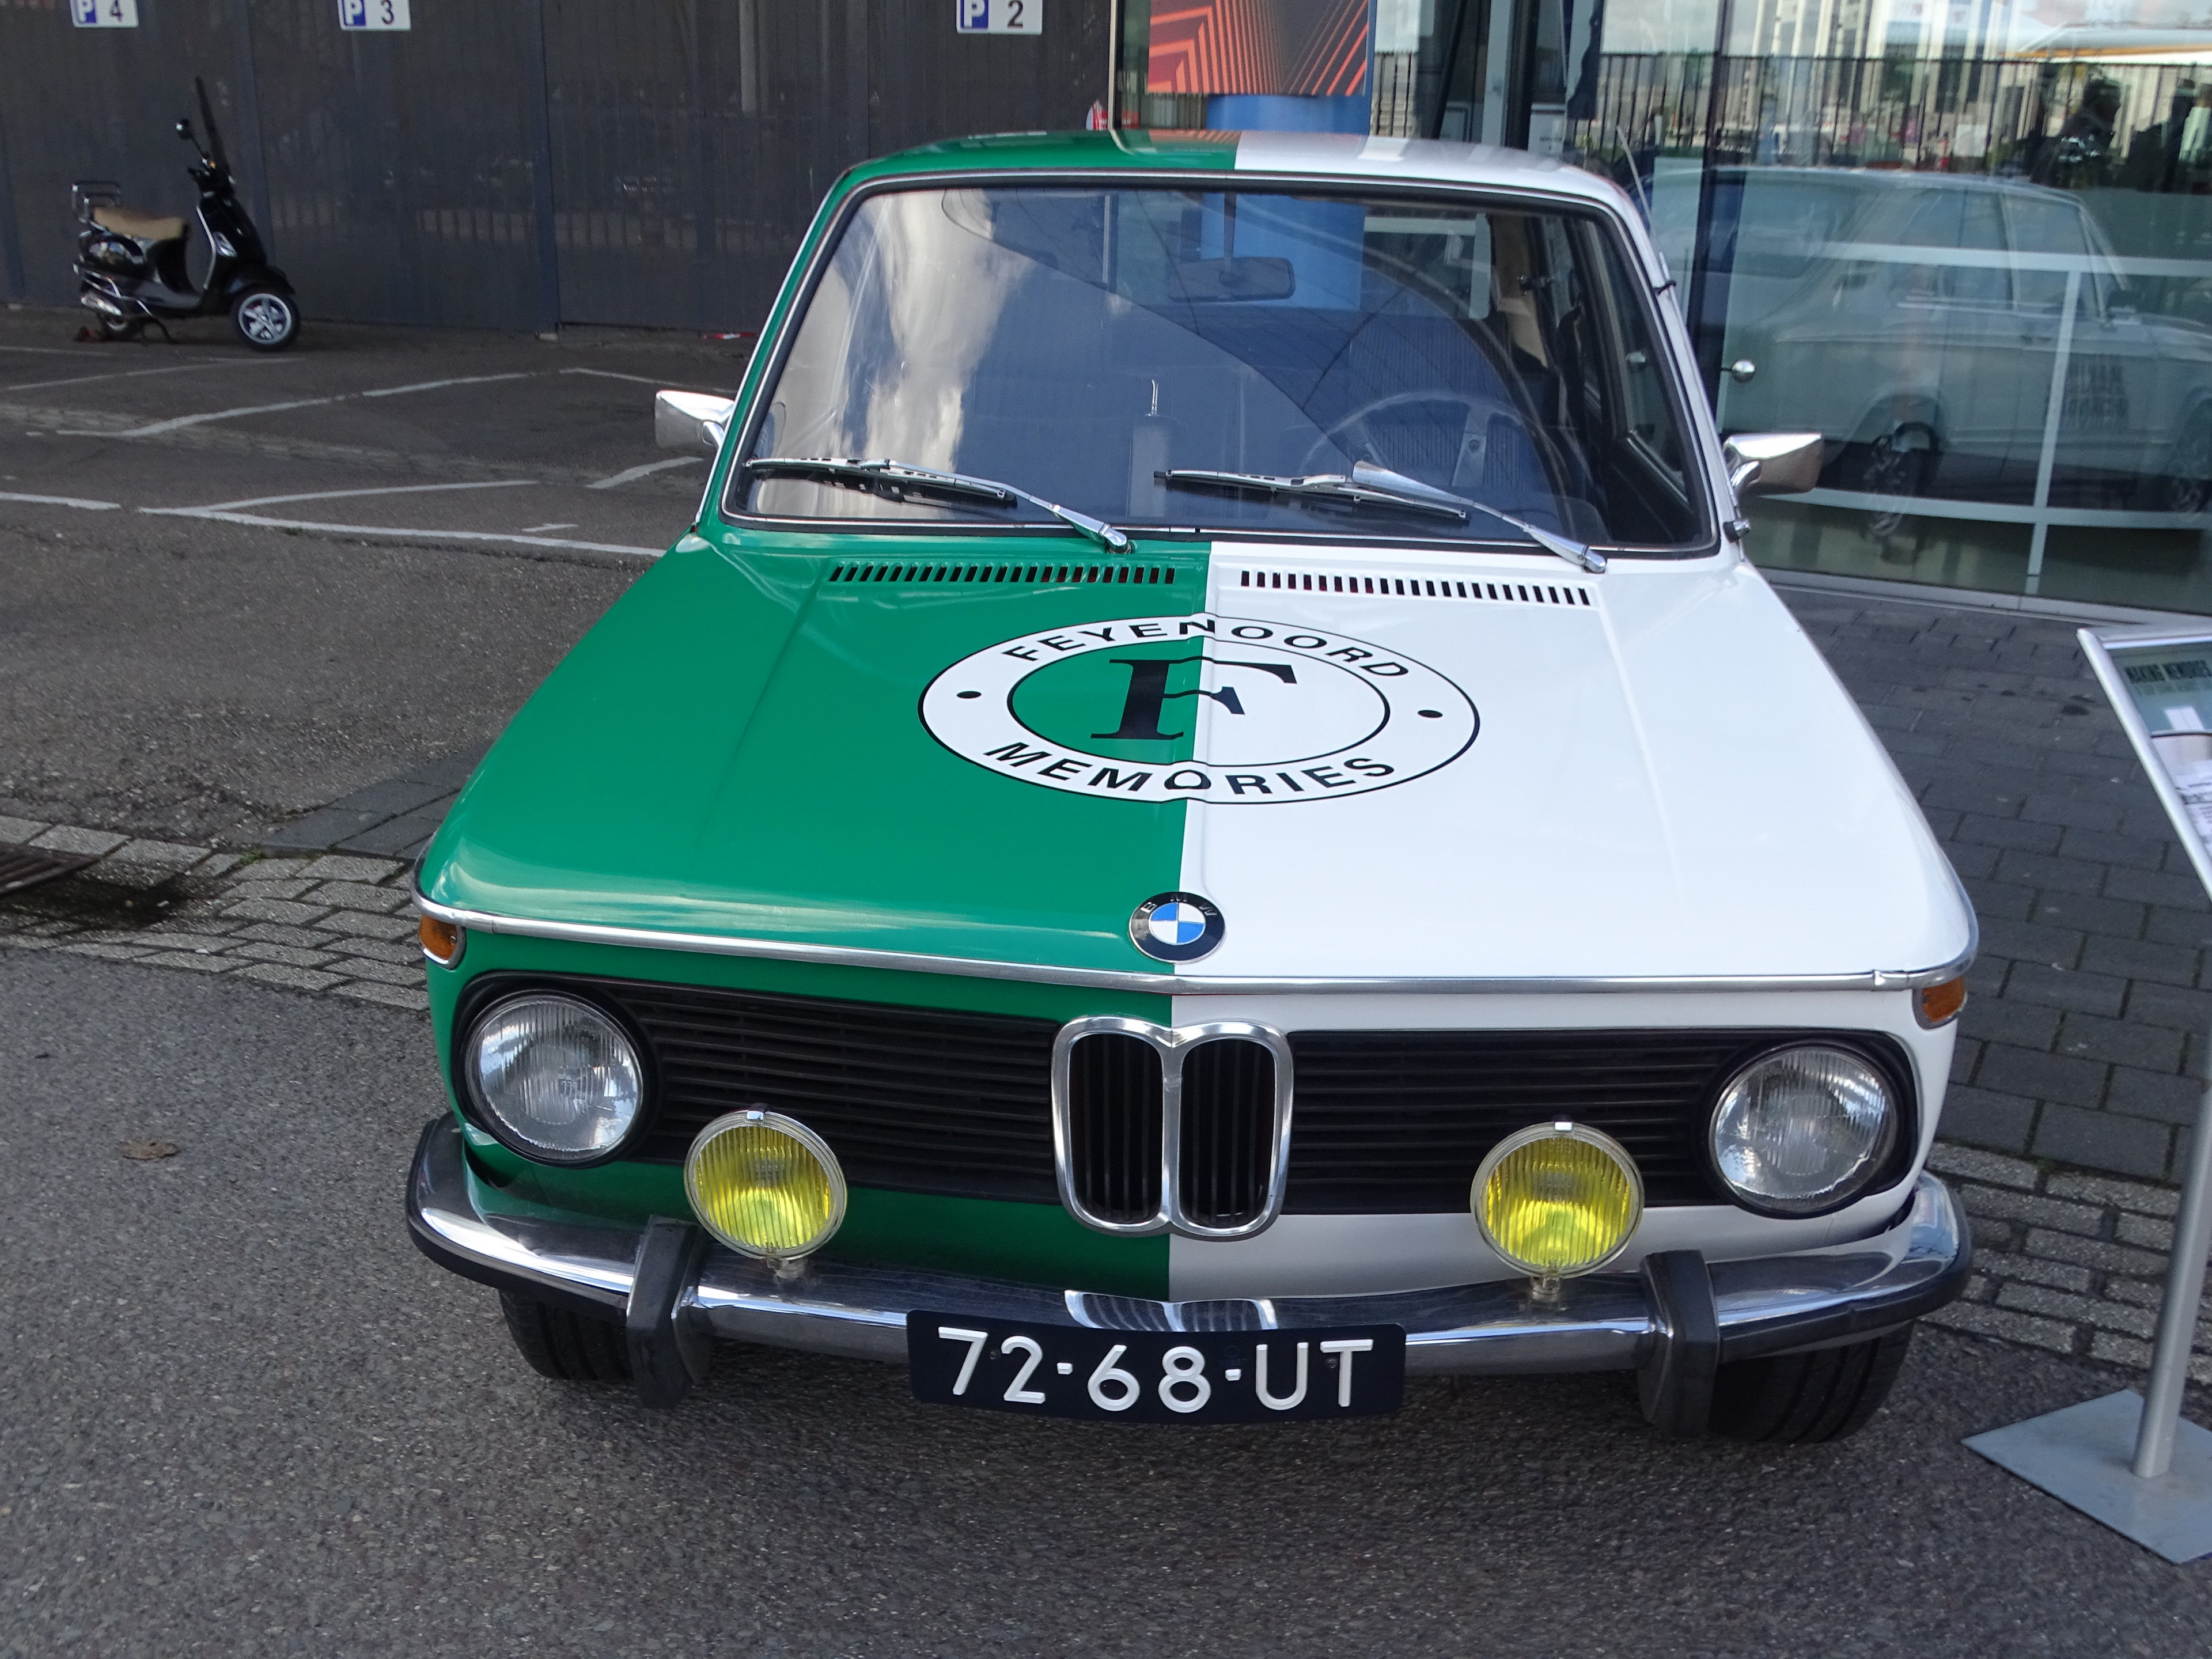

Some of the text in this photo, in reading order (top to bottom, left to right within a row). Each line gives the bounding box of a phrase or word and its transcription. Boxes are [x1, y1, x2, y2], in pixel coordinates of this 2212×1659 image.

[345, 0, 394, 25] P 3
[963, 0, 1023, 28] P 2
[1001, 619, 1410, 680] FEYENOORD
[1090, 656, 1298, 741] F
[984, 741, 1395, 796] MEMORIES
[1140, 893, 1217, 916] BMW
[937, 1325, 1374, 1414] 72-68-UT
